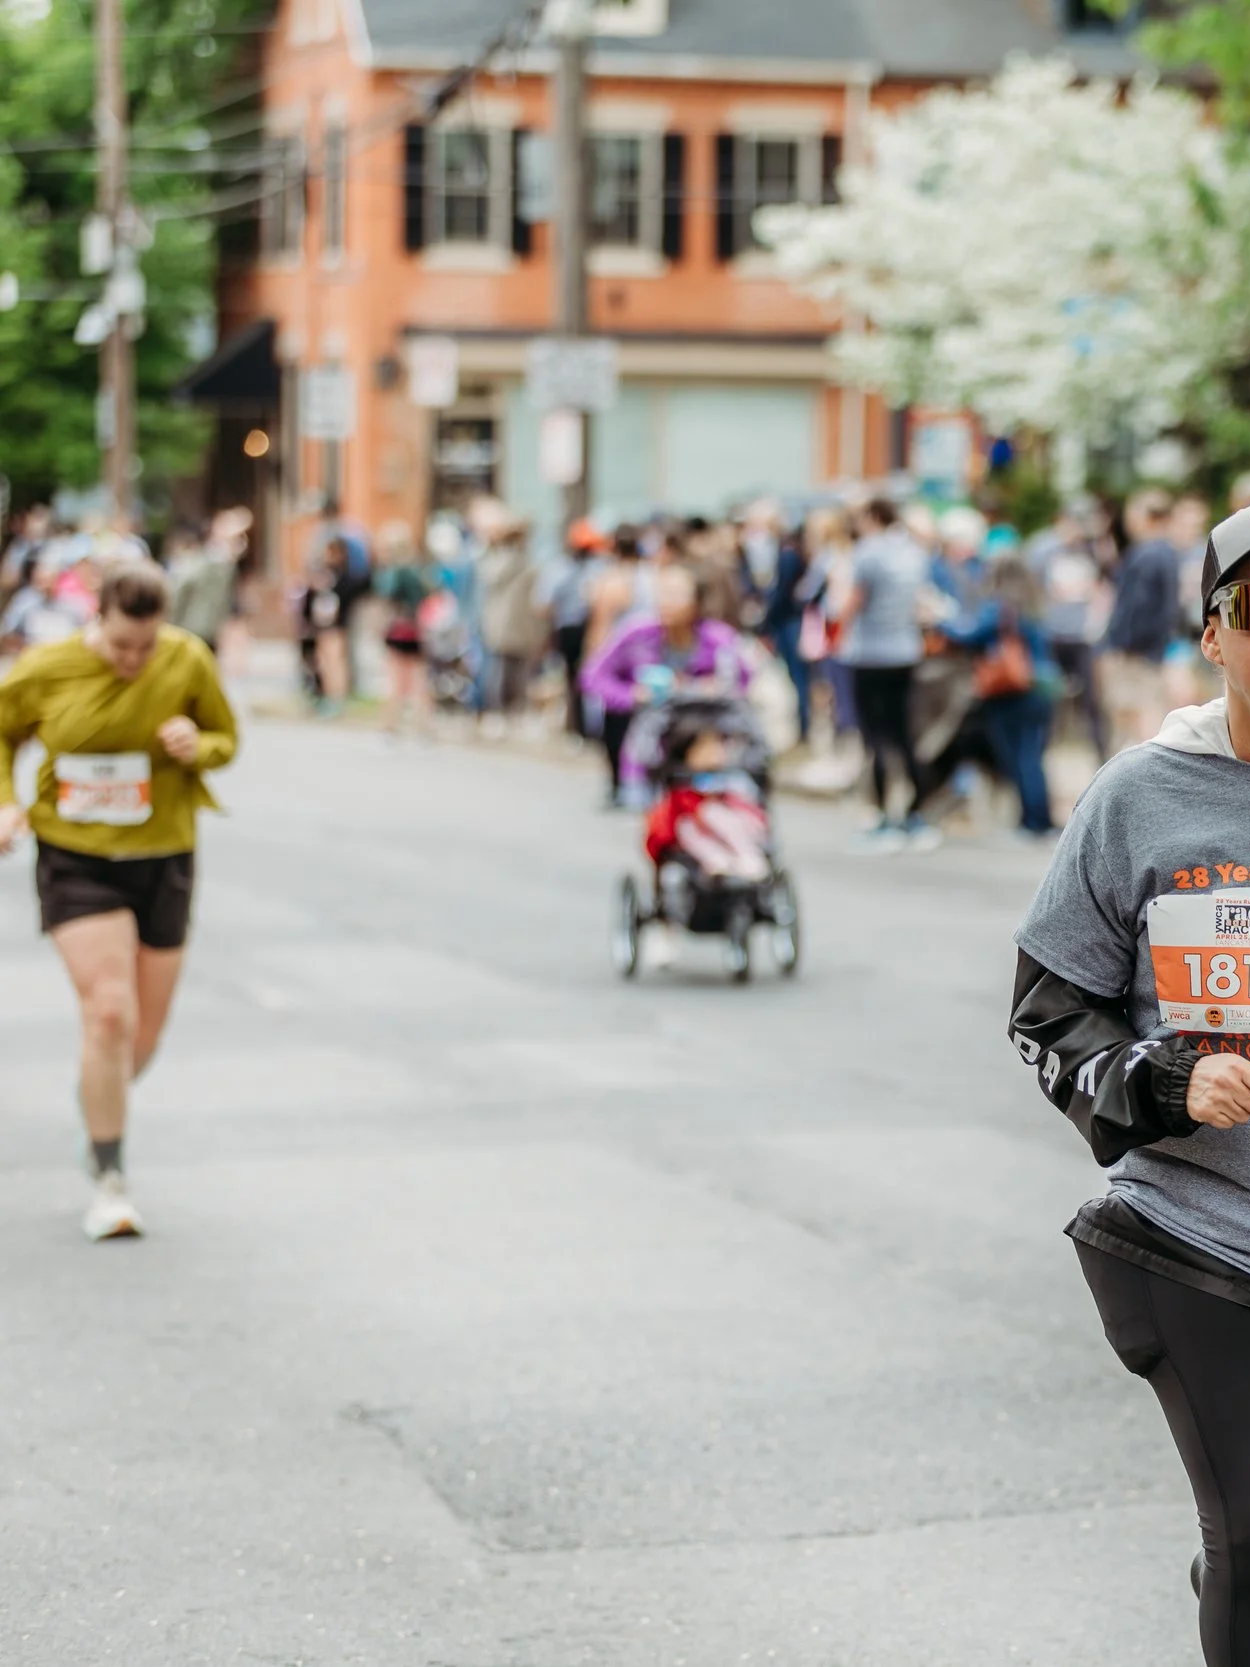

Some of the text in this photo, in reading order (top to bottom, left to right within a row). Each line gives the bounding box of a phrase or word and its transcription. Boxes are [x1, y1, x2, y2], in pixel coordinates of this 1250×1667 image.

[1173, 866, 1211, 889] 28
[1215, 905, 1223, 933] ywca
[1168, 1011, 1191, 1021] ywca
